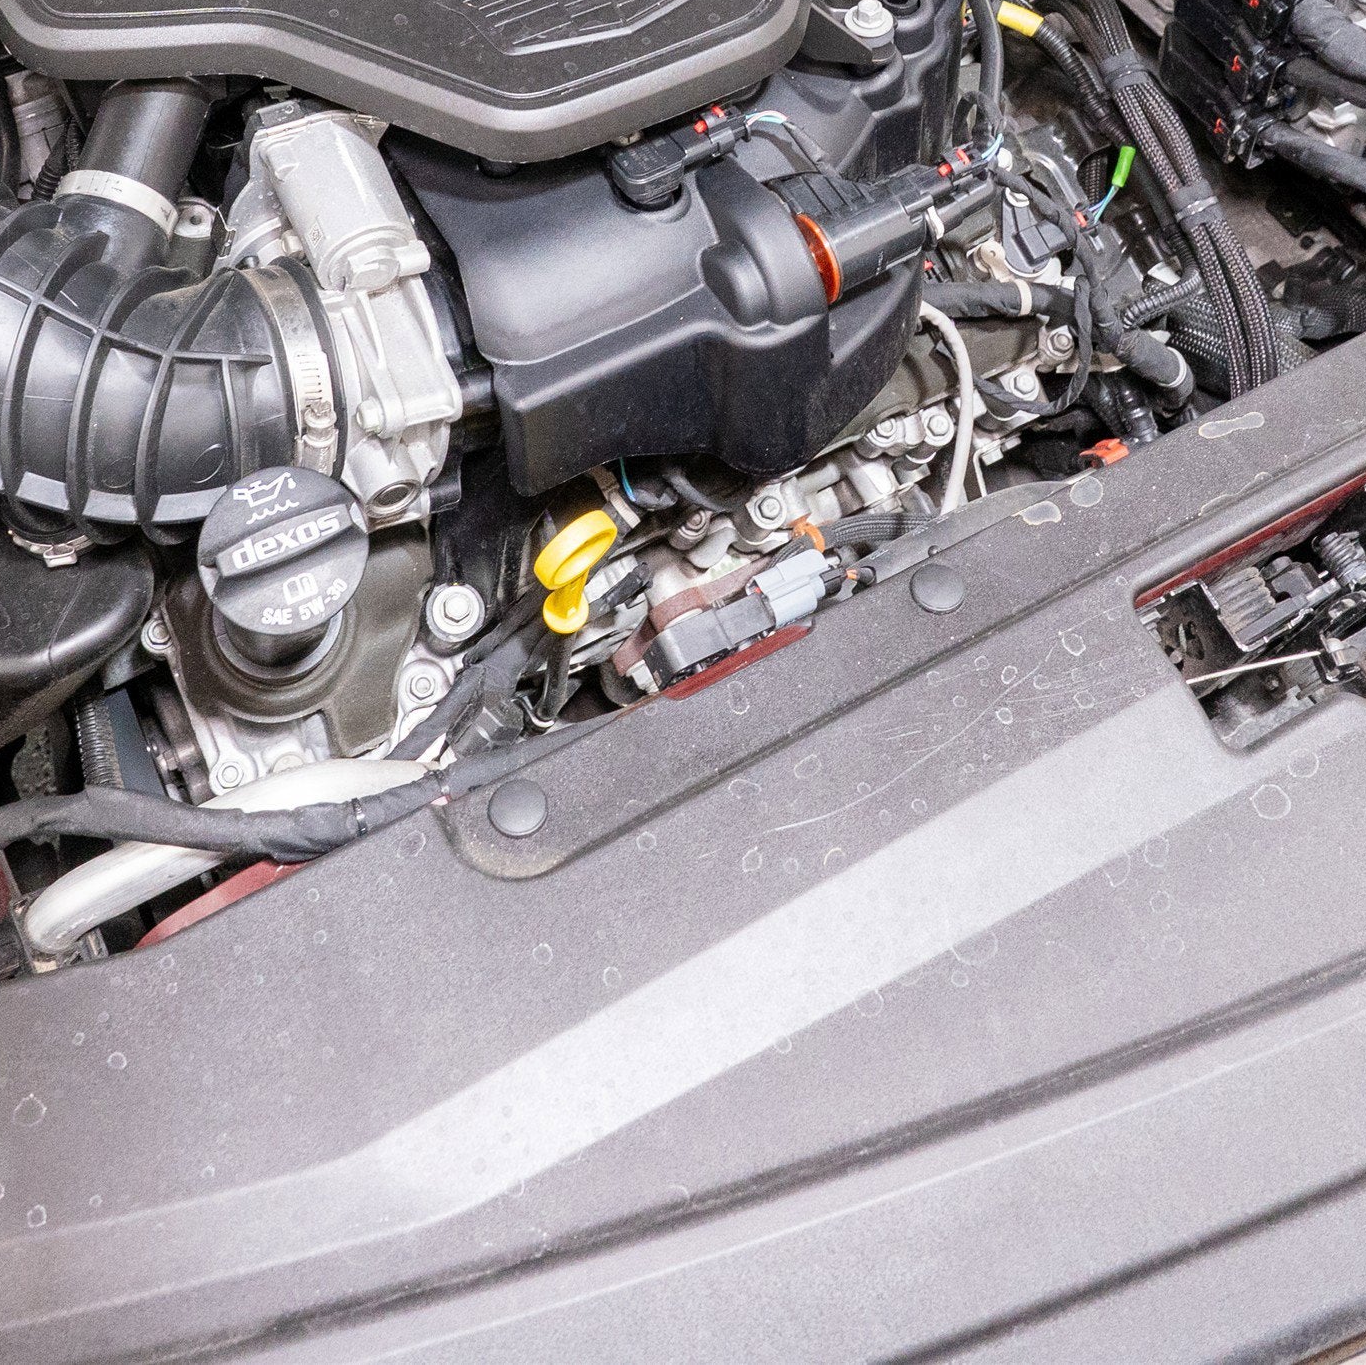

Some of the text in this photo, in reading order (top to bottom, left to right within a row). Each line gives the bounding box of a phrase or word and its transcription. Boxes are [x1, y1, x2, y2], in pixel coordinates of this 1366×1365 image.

[231, 511, 340, 569] dexos
[261, 578, 348, 625] SAE 5W-30
